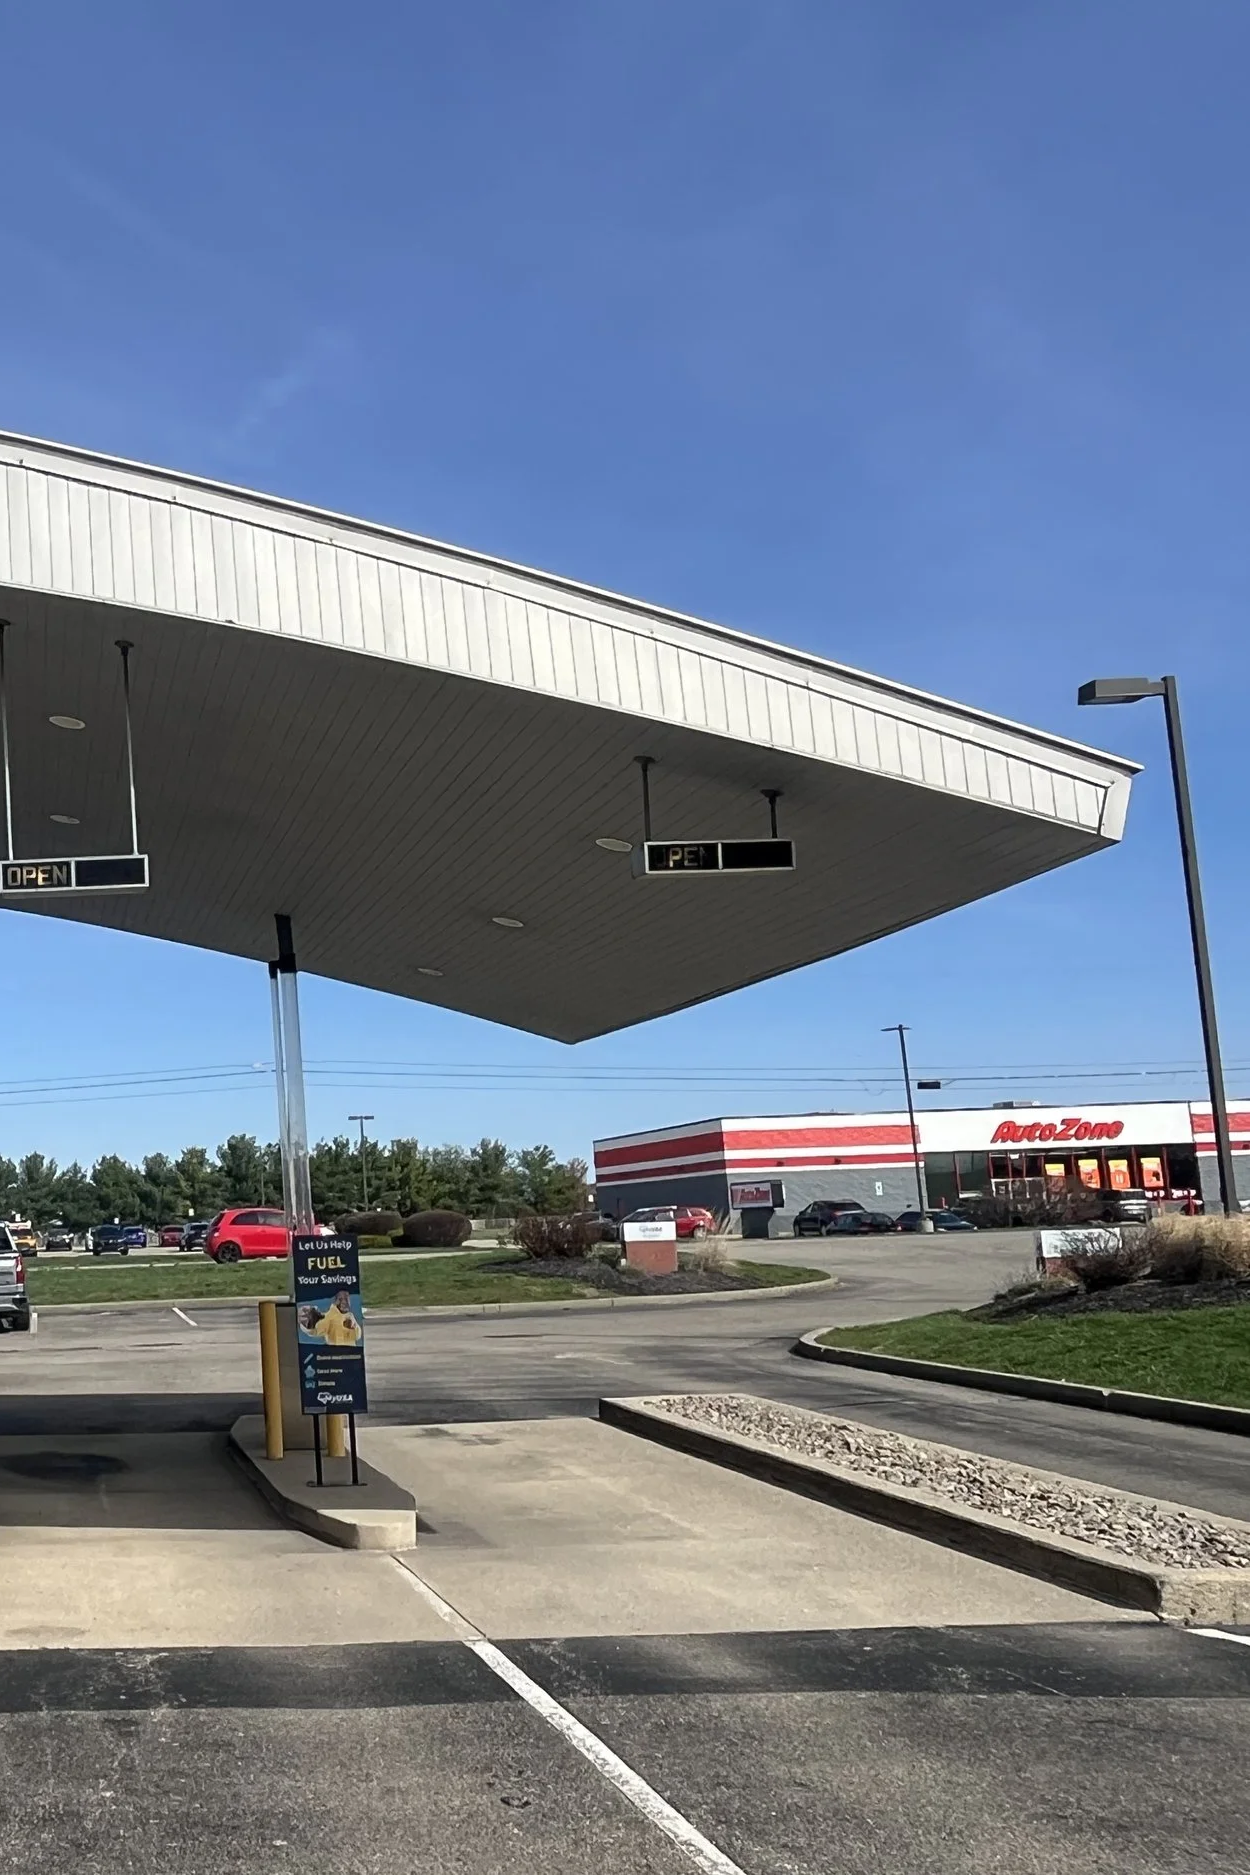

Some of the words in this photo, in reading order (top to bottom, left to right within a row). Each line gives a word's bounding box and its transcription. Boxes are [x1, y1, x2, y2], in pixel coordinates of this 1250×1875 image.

[7, 865, 67, 887] OPEN
[989, 1117, 1125, 1144] AutoZone
[298, 1241, 315, 1251] Let
[315, 1240, 328, 1250] Us
[330, 1240, 352, 1251] Help
[307, 1255, 347, 1270] FUEL
[297, 1275, 319, 1285] Your
[320, 1273, 357, 1285] Savings
